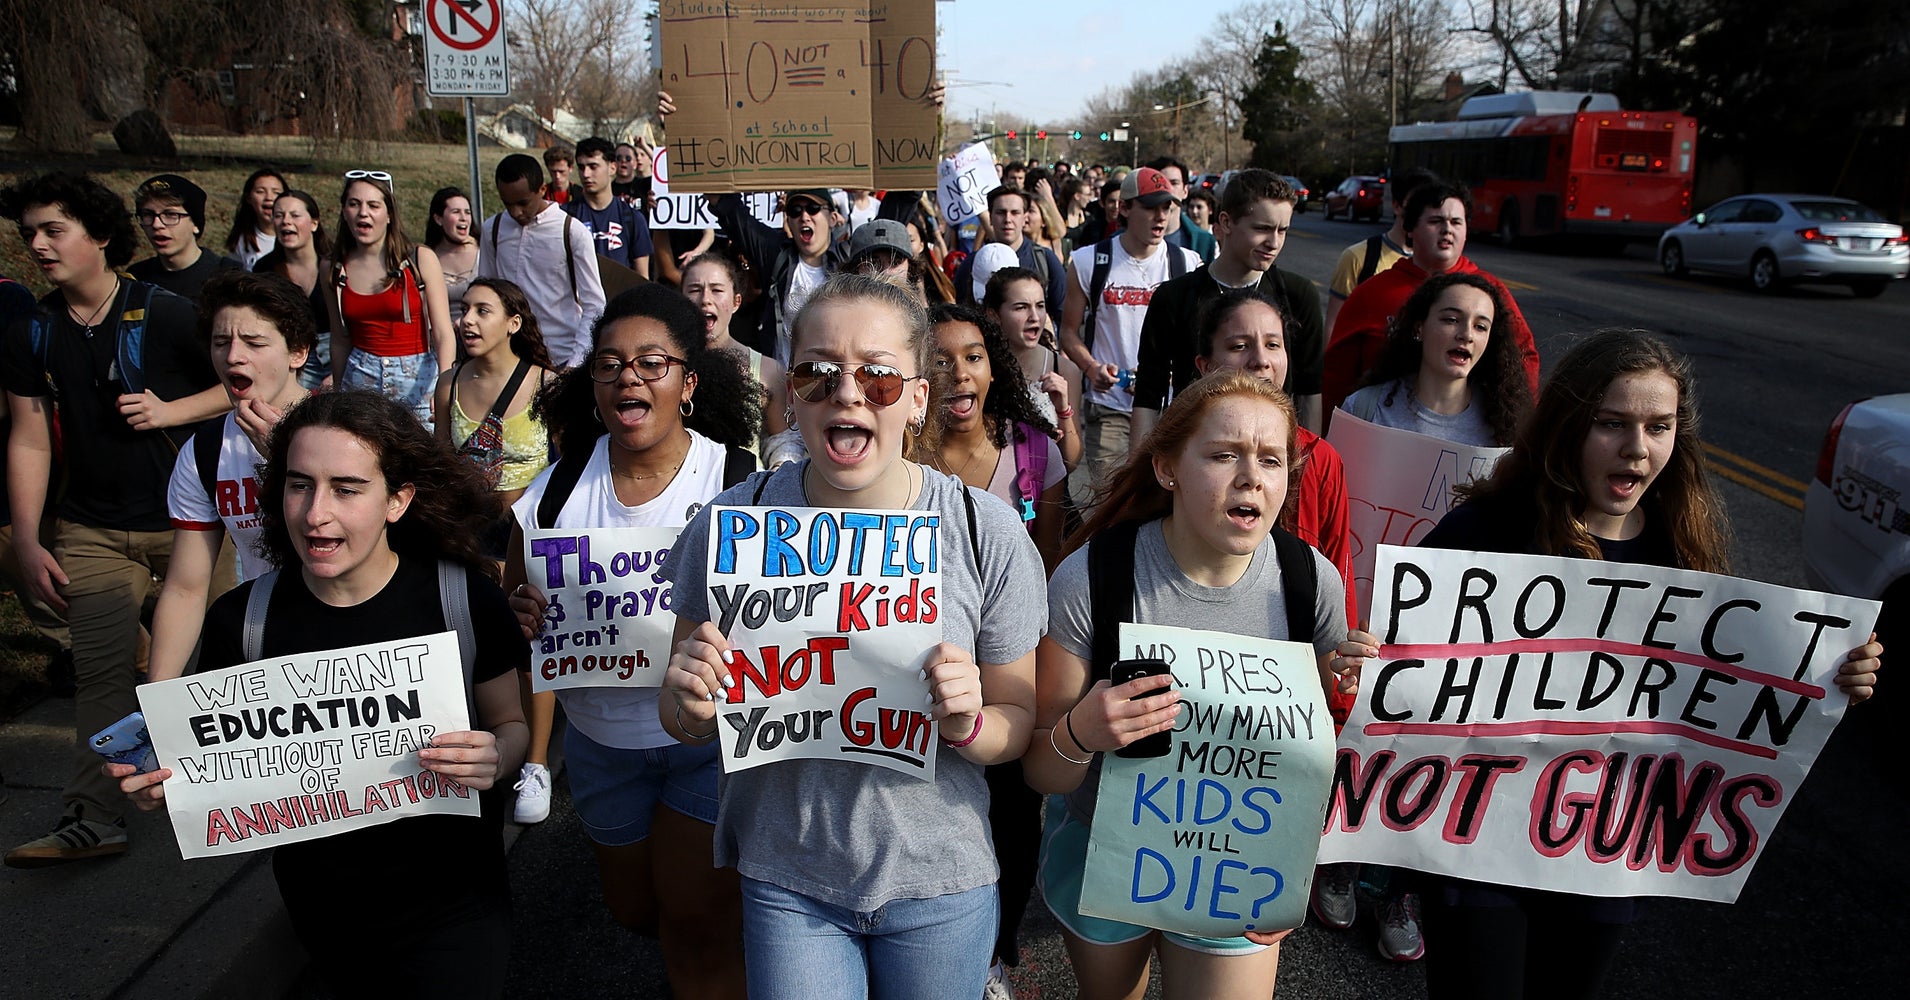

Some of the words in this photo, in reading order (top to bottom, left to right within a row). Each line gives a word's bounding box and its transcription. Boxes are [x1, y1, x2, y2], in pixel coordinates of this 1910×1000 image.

[805, 8, 846, 18] worry
[855, 5, 888, 17] about
[433, 68, 457, 80] 3:30
[490, 69, 504, 80] PM
[485, 56, 500, 67] AM
[670, 72, 678, 82] a
[784, 44, 830, 65] NOT
[837, 69, 845, 78] a
[435, 83, 467, 91] MONDAY
[475, 83, 501, 91] FRIDAY
[746, 123, 760, 134] at
[671, 138, 869, 172] #GUNCONTROL
[877, 136, 936, 164] NOW
[946, 168, 977, 200] NOT
[653, 195, 710, 225] OUR
[1836, 475, 1897, 534] 911
[714, 510, 940, 577] PROTECT
[837, 578, 938, 632] Kids
[1385, 562, 1852, 682] PROTECT
[541, 624, 620, 655] aren't
[186, 669, 269, 711] WE
[281, 644, 429, 698] WANT
[541, 650, 650, 680] enough
[726, 637, 850, 704] NOT
[1197, 647, 1292, 698] PRES,
[189, 690, 421, 747] EDUCATION
[1172, 699, 1224, 735] OW
[1229, 702, 1314, 741] MANY
[1370, 652, 1812, 746] CHILDREN
[178, 740, 343, 784] WITHOUT
[351, 725, 440, 759] FEAR
[1177, 741, 1282, 779] MORE
[300, 768, 340, 793] OF
[206, 769, 470, 846] ANNIHILATION
[1132, 773, 1283, 835] KIDS
[1322, 749, 1526, 844] NOT
[1529, 750, 1784, 877] GUNS
[1174, 829, 1240, 854] WILL
[1131, 847, 1284, 930] DIE?
